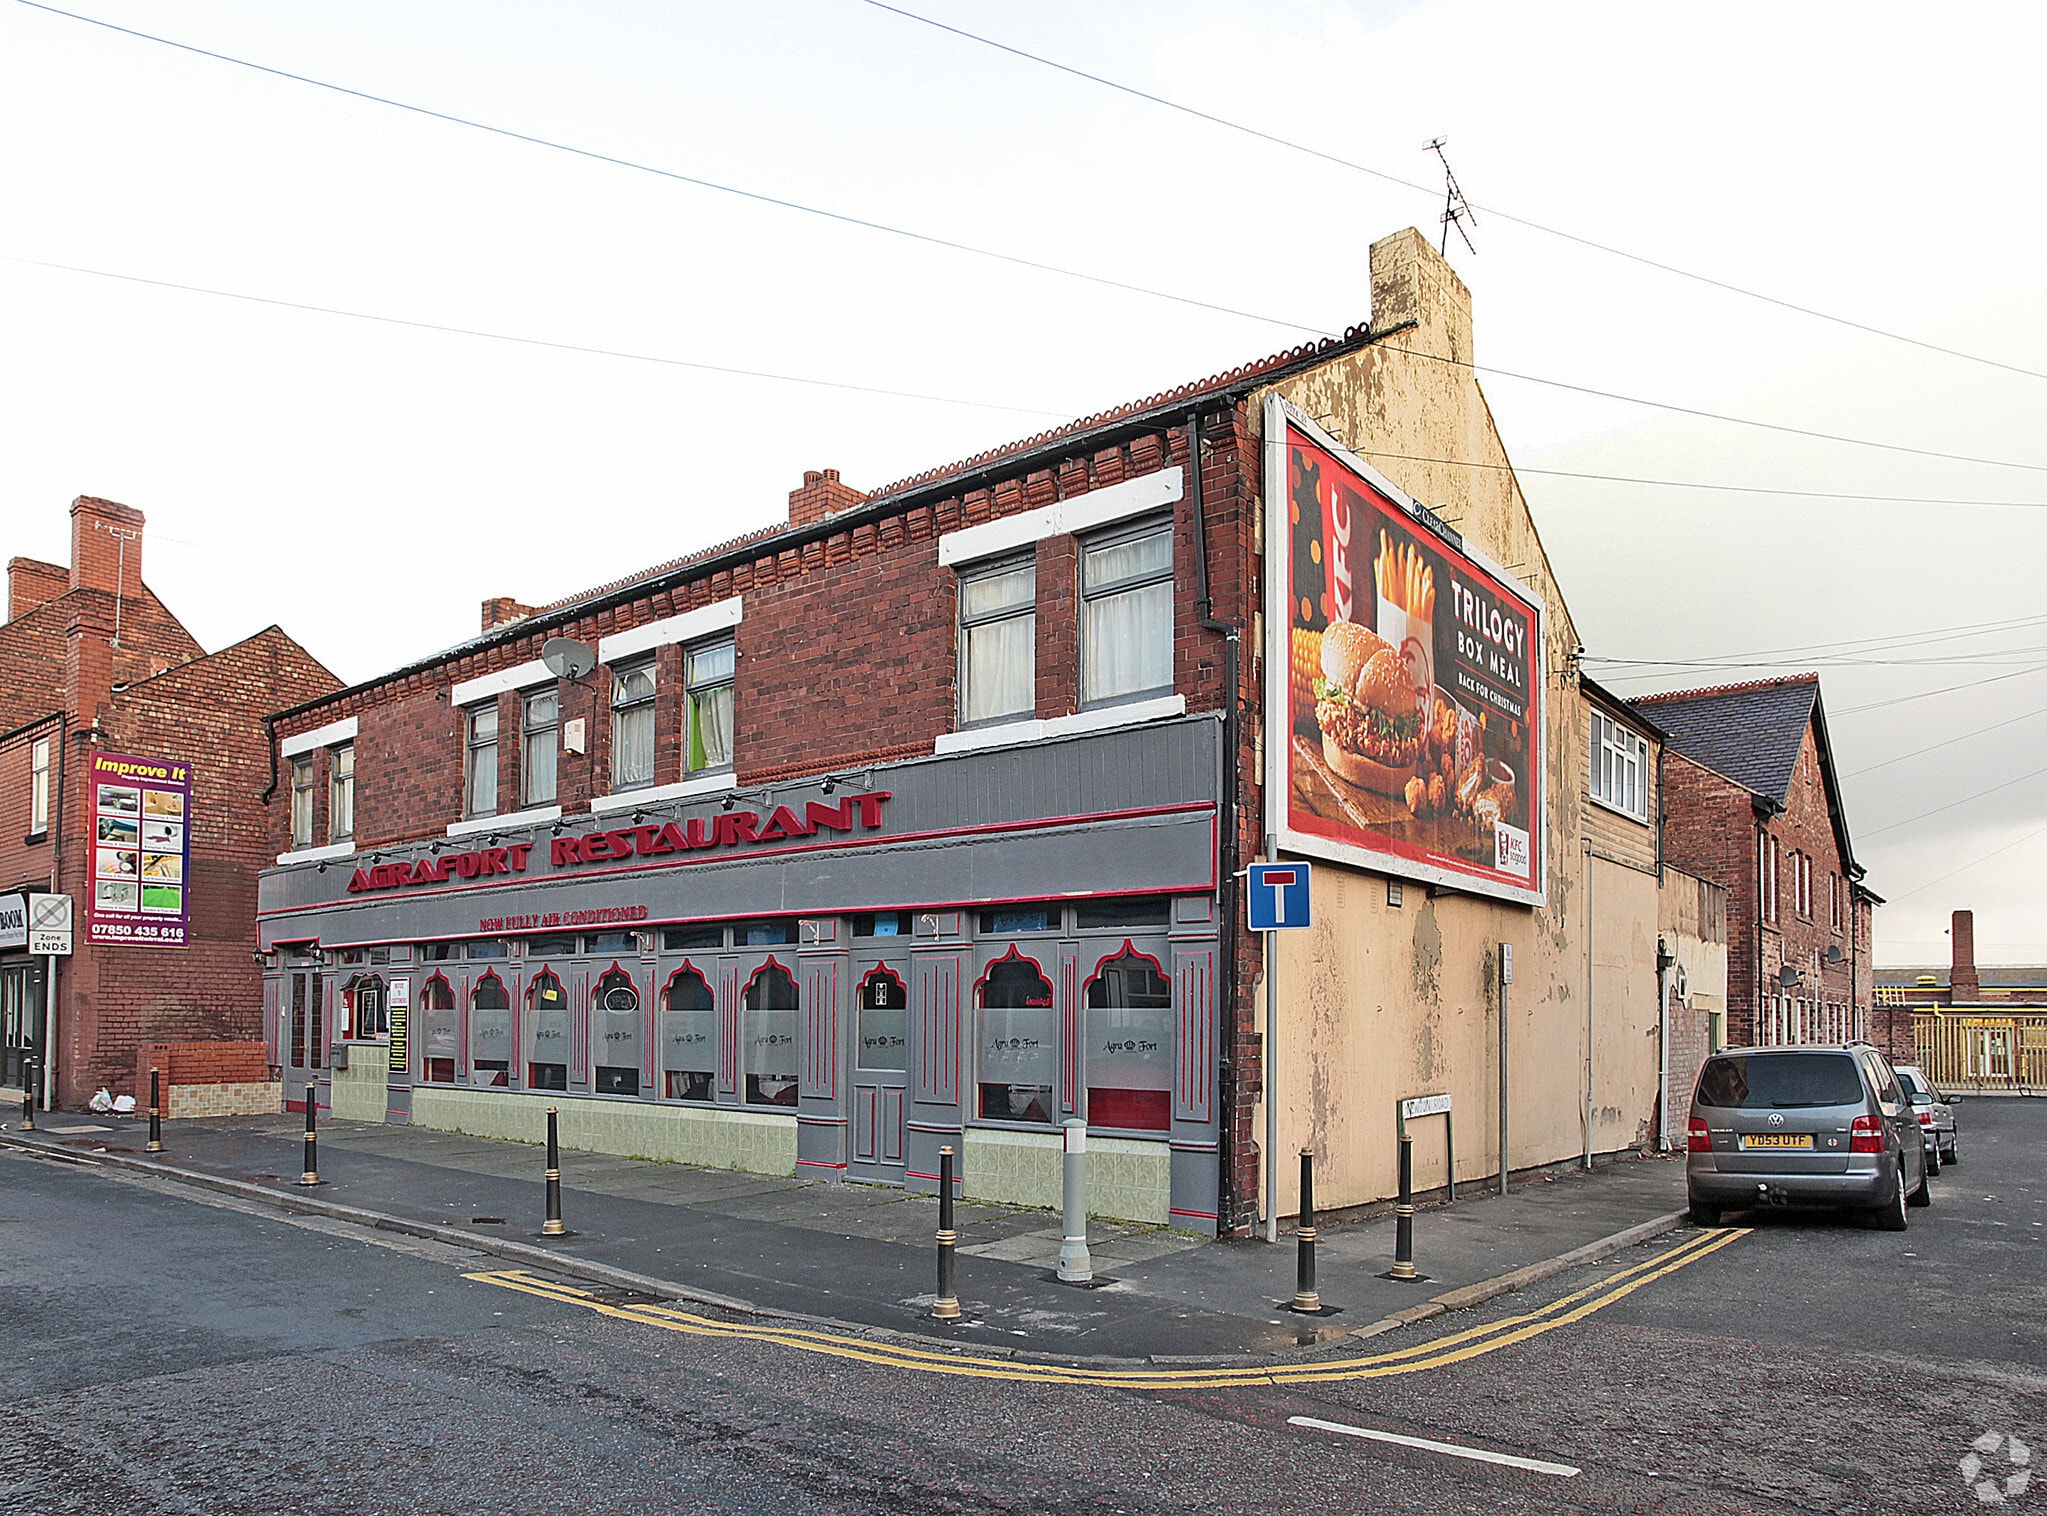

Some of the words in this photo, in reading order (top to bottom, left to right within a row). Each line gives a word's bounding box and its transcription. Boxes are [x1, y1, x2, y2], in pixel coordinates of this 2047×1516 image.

[1331, 482, 1352, 622] KFC
[1452, 580, 1523, 659] TRILOGY
[1458, 631, 1483, 665] BOX
[1490, 651, 1520, 687] MEAL
[1458, 672, 1475, 692] BACK
[1476, 682, 1488, 699] FOR
[1489, 690, 1521, 717] CHRISTMAS
[95, 757, 167, 778] Improve
[172, 767, 186, 780] It
[346, 843, 533, 893] AGRAFORT
[551, 791, 892, 866] RESTAURANT
[1511, 838, 1522, 852] KFC
[480, 918, 505, 931] NOW
[506, 914, 539, 929] FULLY
[541, 912, 560, 926] AIR
[563, 905, 648, 925] CONDITIONED
[40, 933, 61, 941] Zone
[92, 924, 132, 935] 07850
[134, 926, 158, 936] 435
[161, 927, 184, 937] 616
[34, 942, 67, 951] ENDS
[672, 1034, 686, 1046] Agra
[694, 1034, 706, 1043] Fort
[755, 1034, 770, 1046] Agra
[779, 1035, 792, 1045] Fort
[863, 1036, 877, 1049] Agra
[889, 1036, 905, 1047] Fort
[991, 1038, 1009, 1050] Agra
[1022, 1038, 1039, 1049] Fort
[1103, 1041, 1122, 1054] Agra
[1138, 1040, 1157, 1052] Fort
[1750, 1135, 1780, 1145] YD53
[1783, 1135, 1806, 1145] UTF
